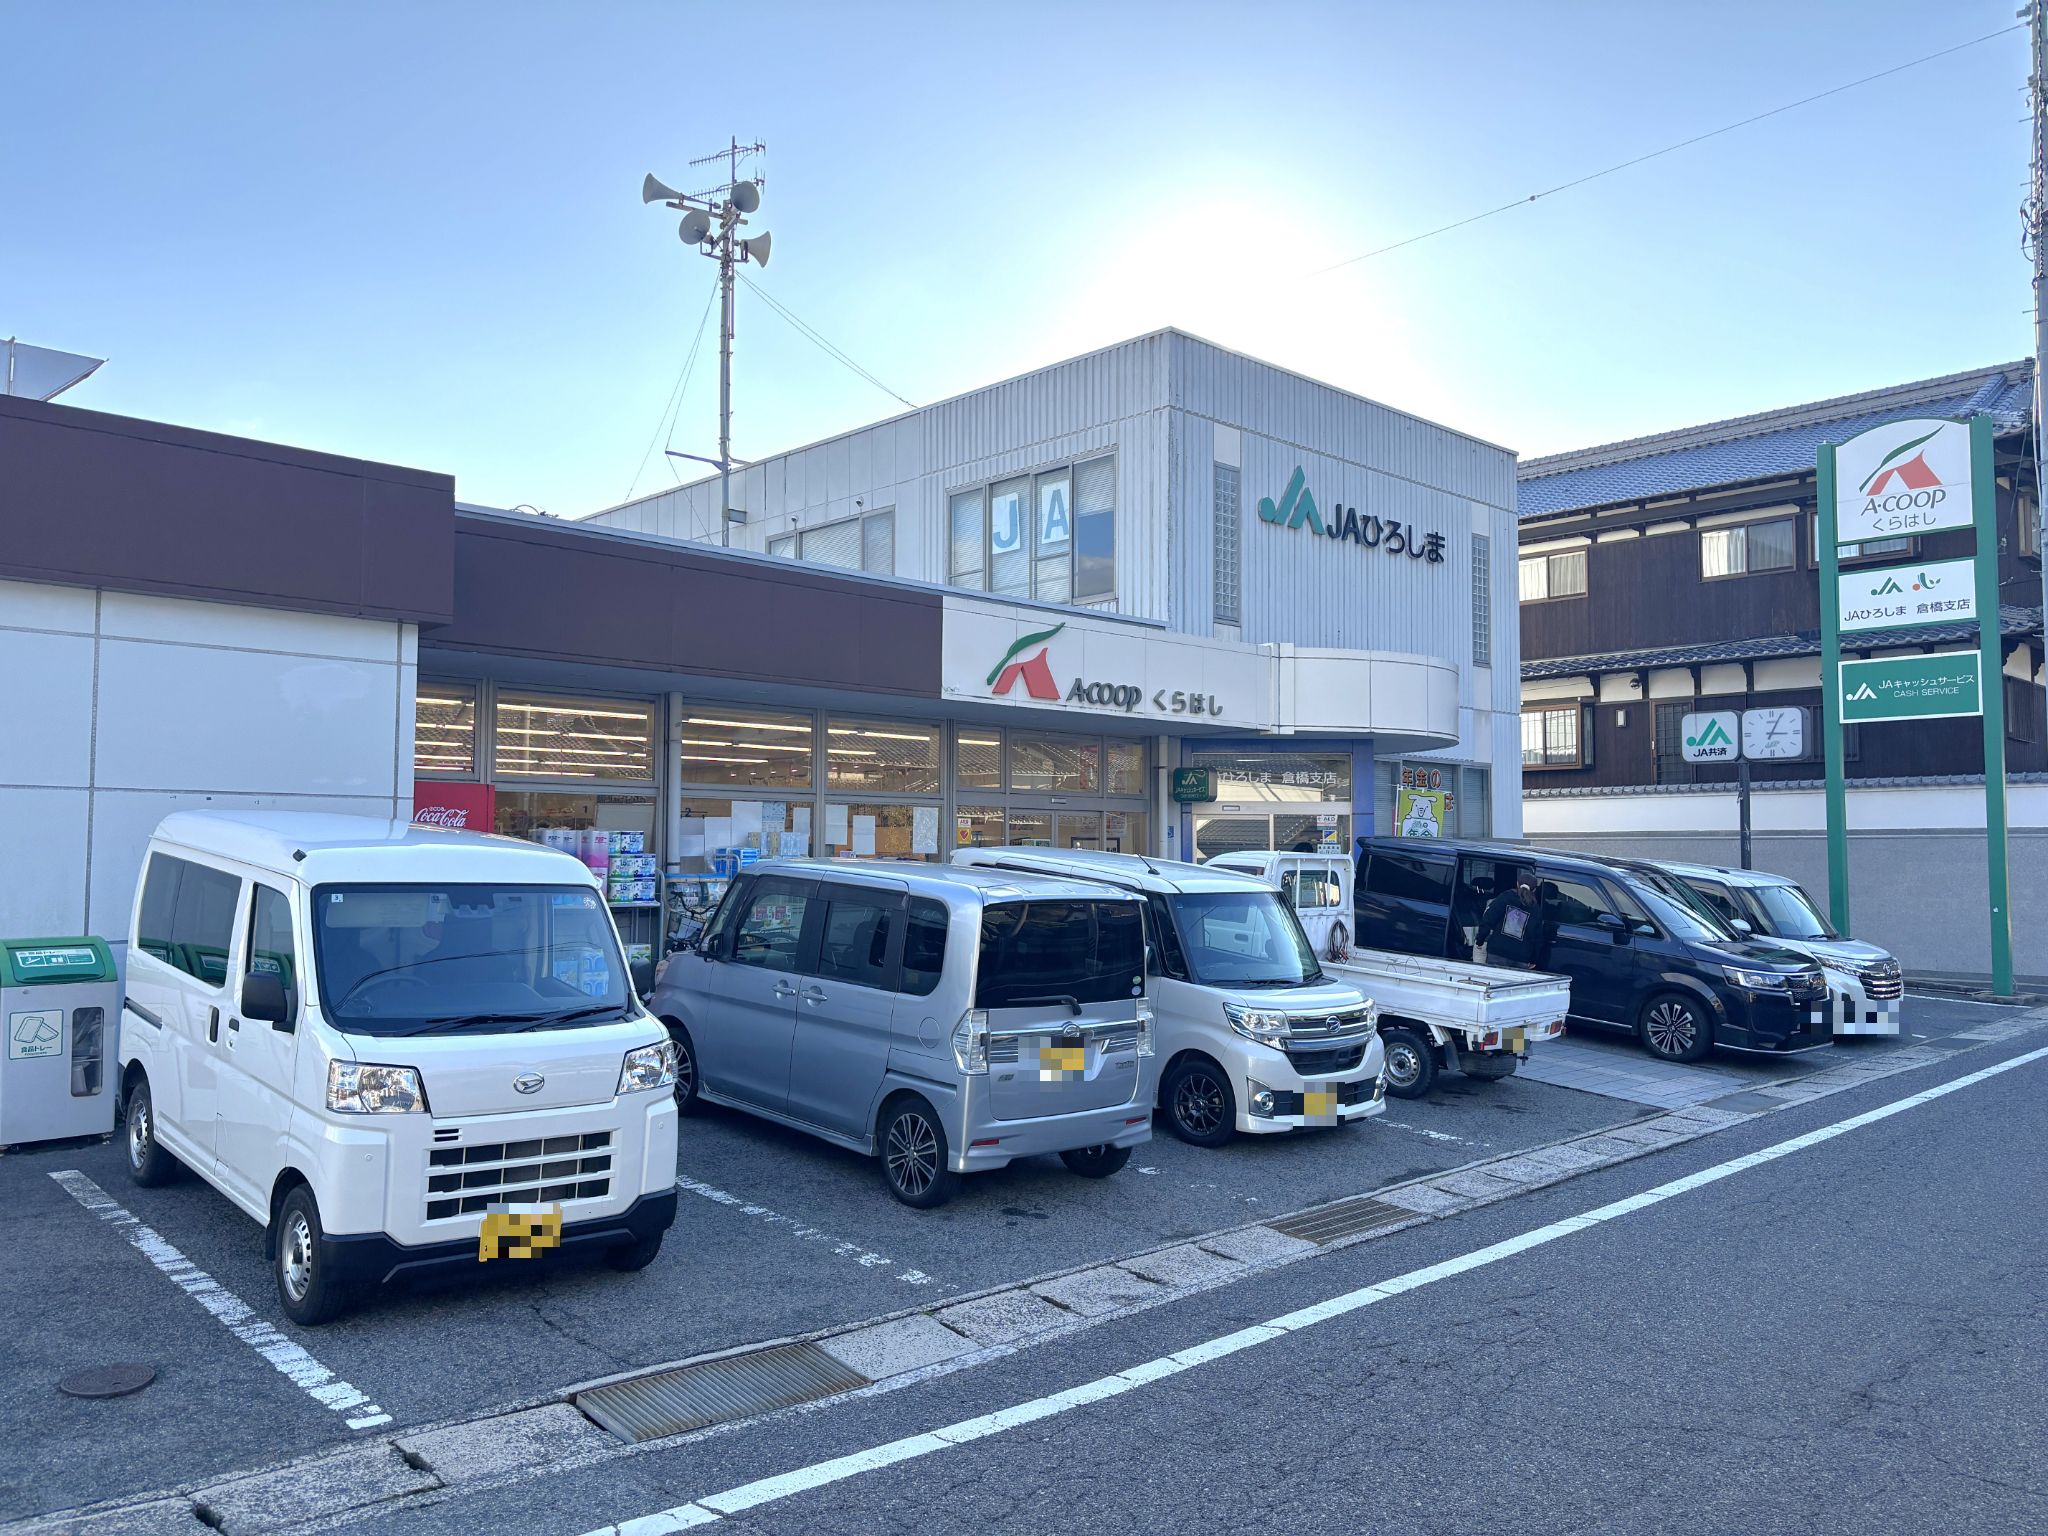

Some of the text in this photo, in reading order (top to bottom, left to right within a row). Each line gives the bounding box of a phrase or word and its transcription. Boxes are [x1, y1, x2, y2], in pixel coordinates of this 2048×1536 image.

[1872, 512, 1937, 532] くらはし
[1326, 502, 1447, 564] JAひろしま
[1844, 598, 1971, 622] JAひろしま 倉橋支店
[1878, 674, 1975, 689] JAキャッシュサービス
[1893, 684, 1960, 698] CASH SERVICE
[1153, 689, 1224, 716] くらはし
[1692, 747, 1728, 758] JA共済
[1281, 771, 1338, 785] 倉橋支店
[414, 808, 470, 827] Coca-Cola
